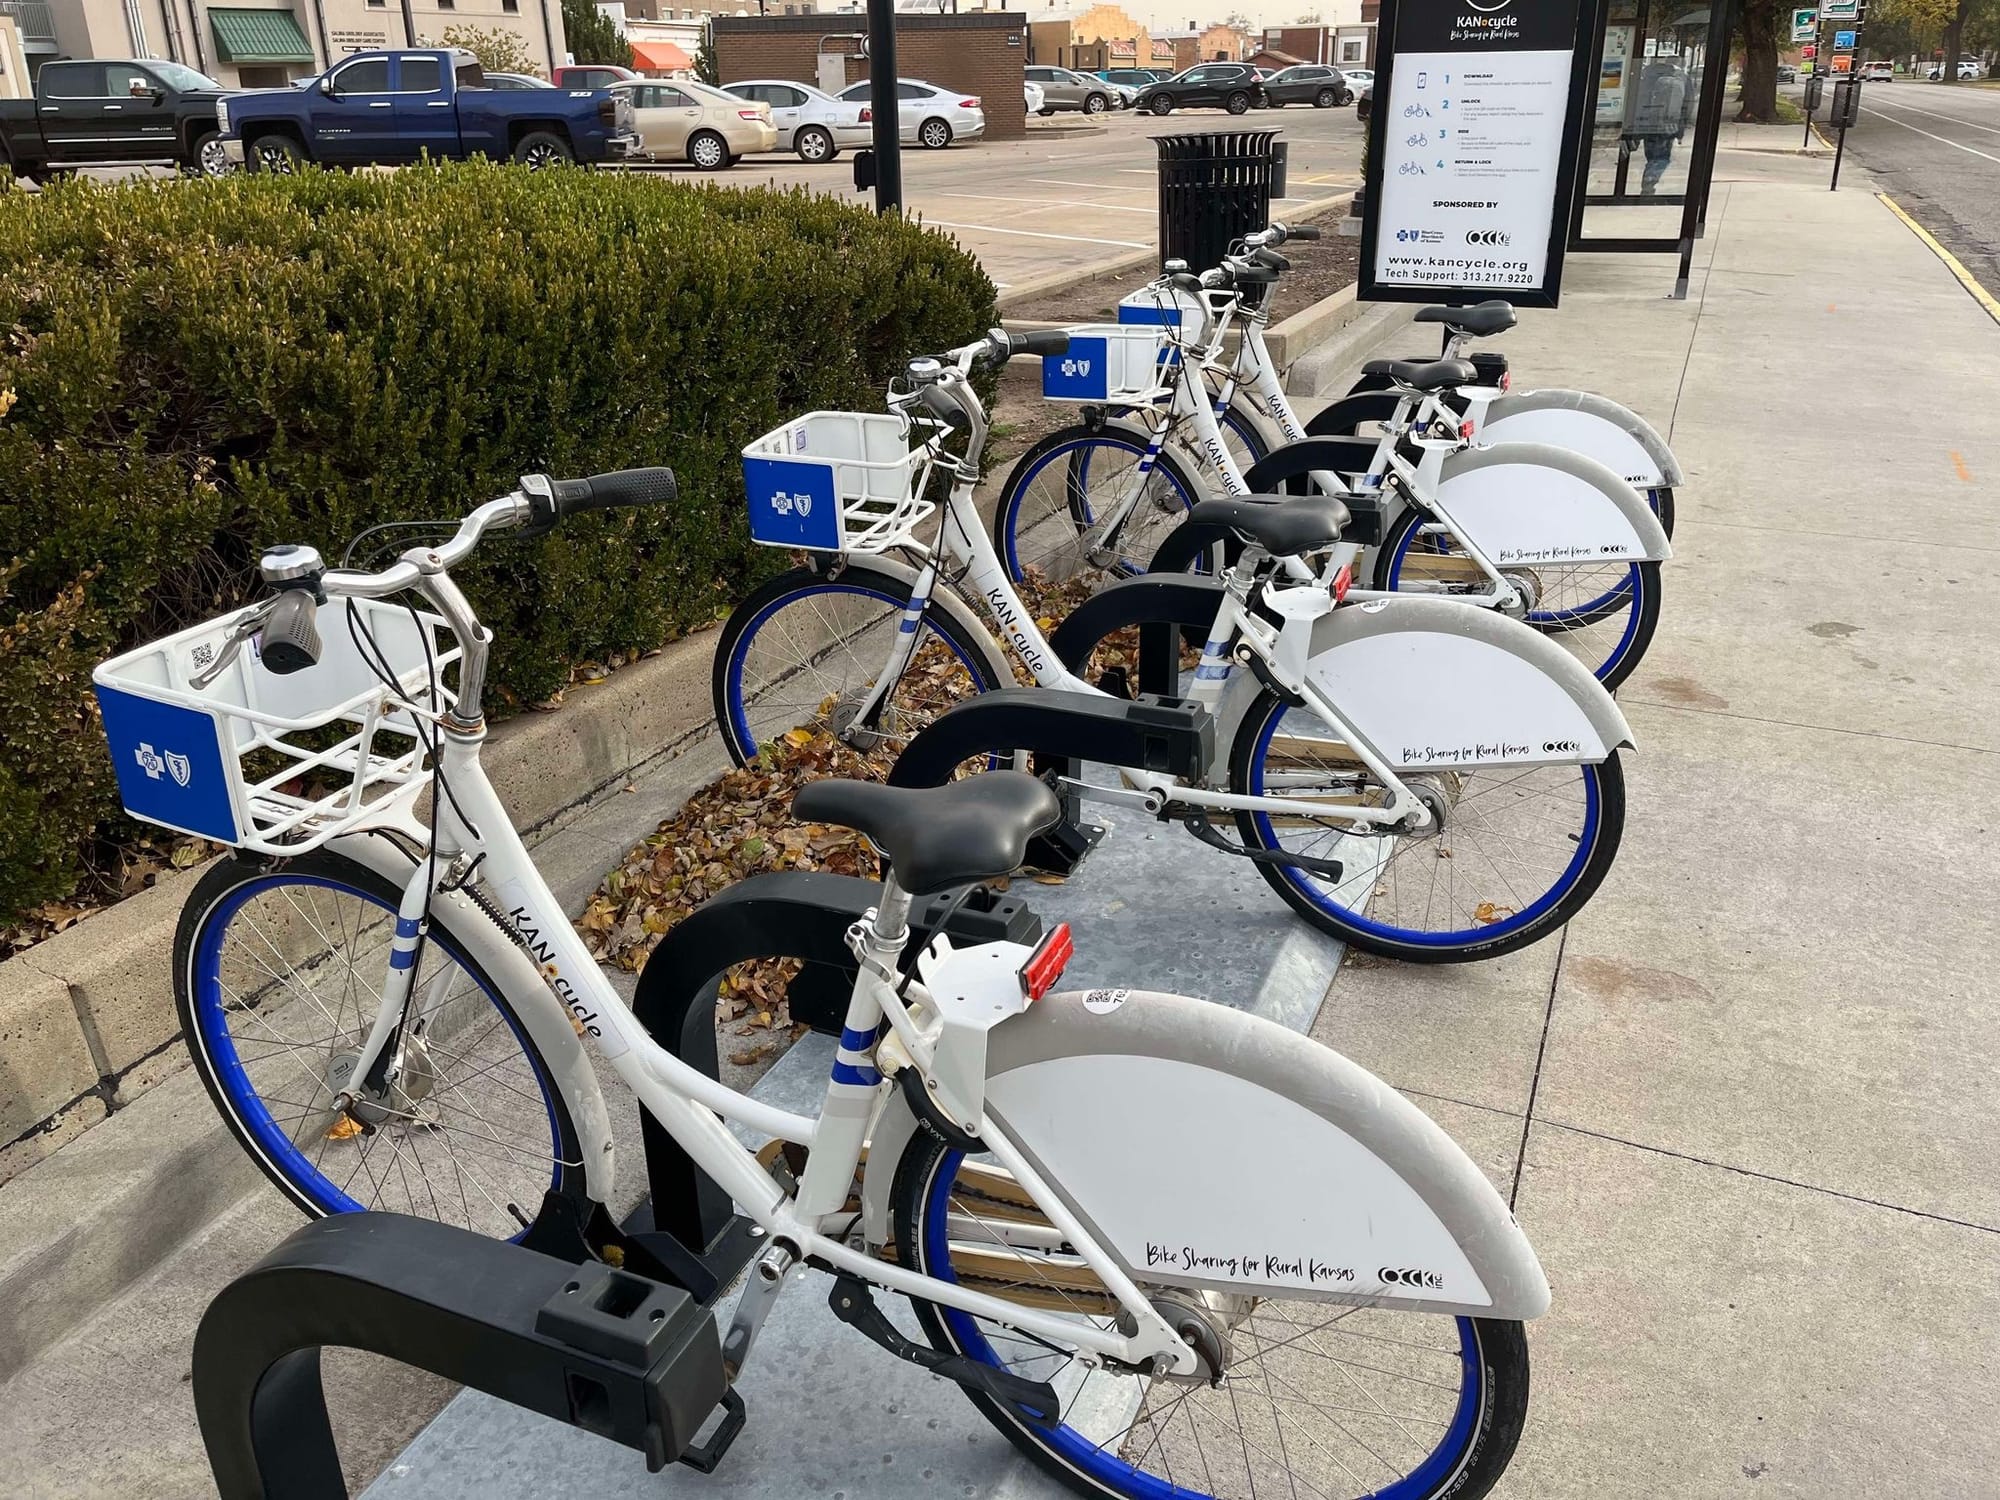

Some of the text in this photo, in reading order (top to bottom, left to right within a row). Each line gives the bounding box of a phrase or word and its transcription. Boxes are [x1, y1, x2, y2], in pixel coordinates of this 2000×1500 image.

[1445, 75, 1450, 84] 1
[1442, 100, 1449, 109] 2
[1439, 129, 1446, 138] 3
[1436, 160, 1444, 169] 4
[1432, 200, 1499, 209] SPONSORED BY
[1388, 256, 1529, 272] www.kancycle.org
[1385, 268, 1534, 284] Tech Support: 313.217.9220
[1500, 548, 1513, 561] Bike
[1402, 743, 1530, 762] Bike Sharing for Rural Kansas
[1146, 1242, 1356, 1282] Bike Sharing for Rural Kansas
